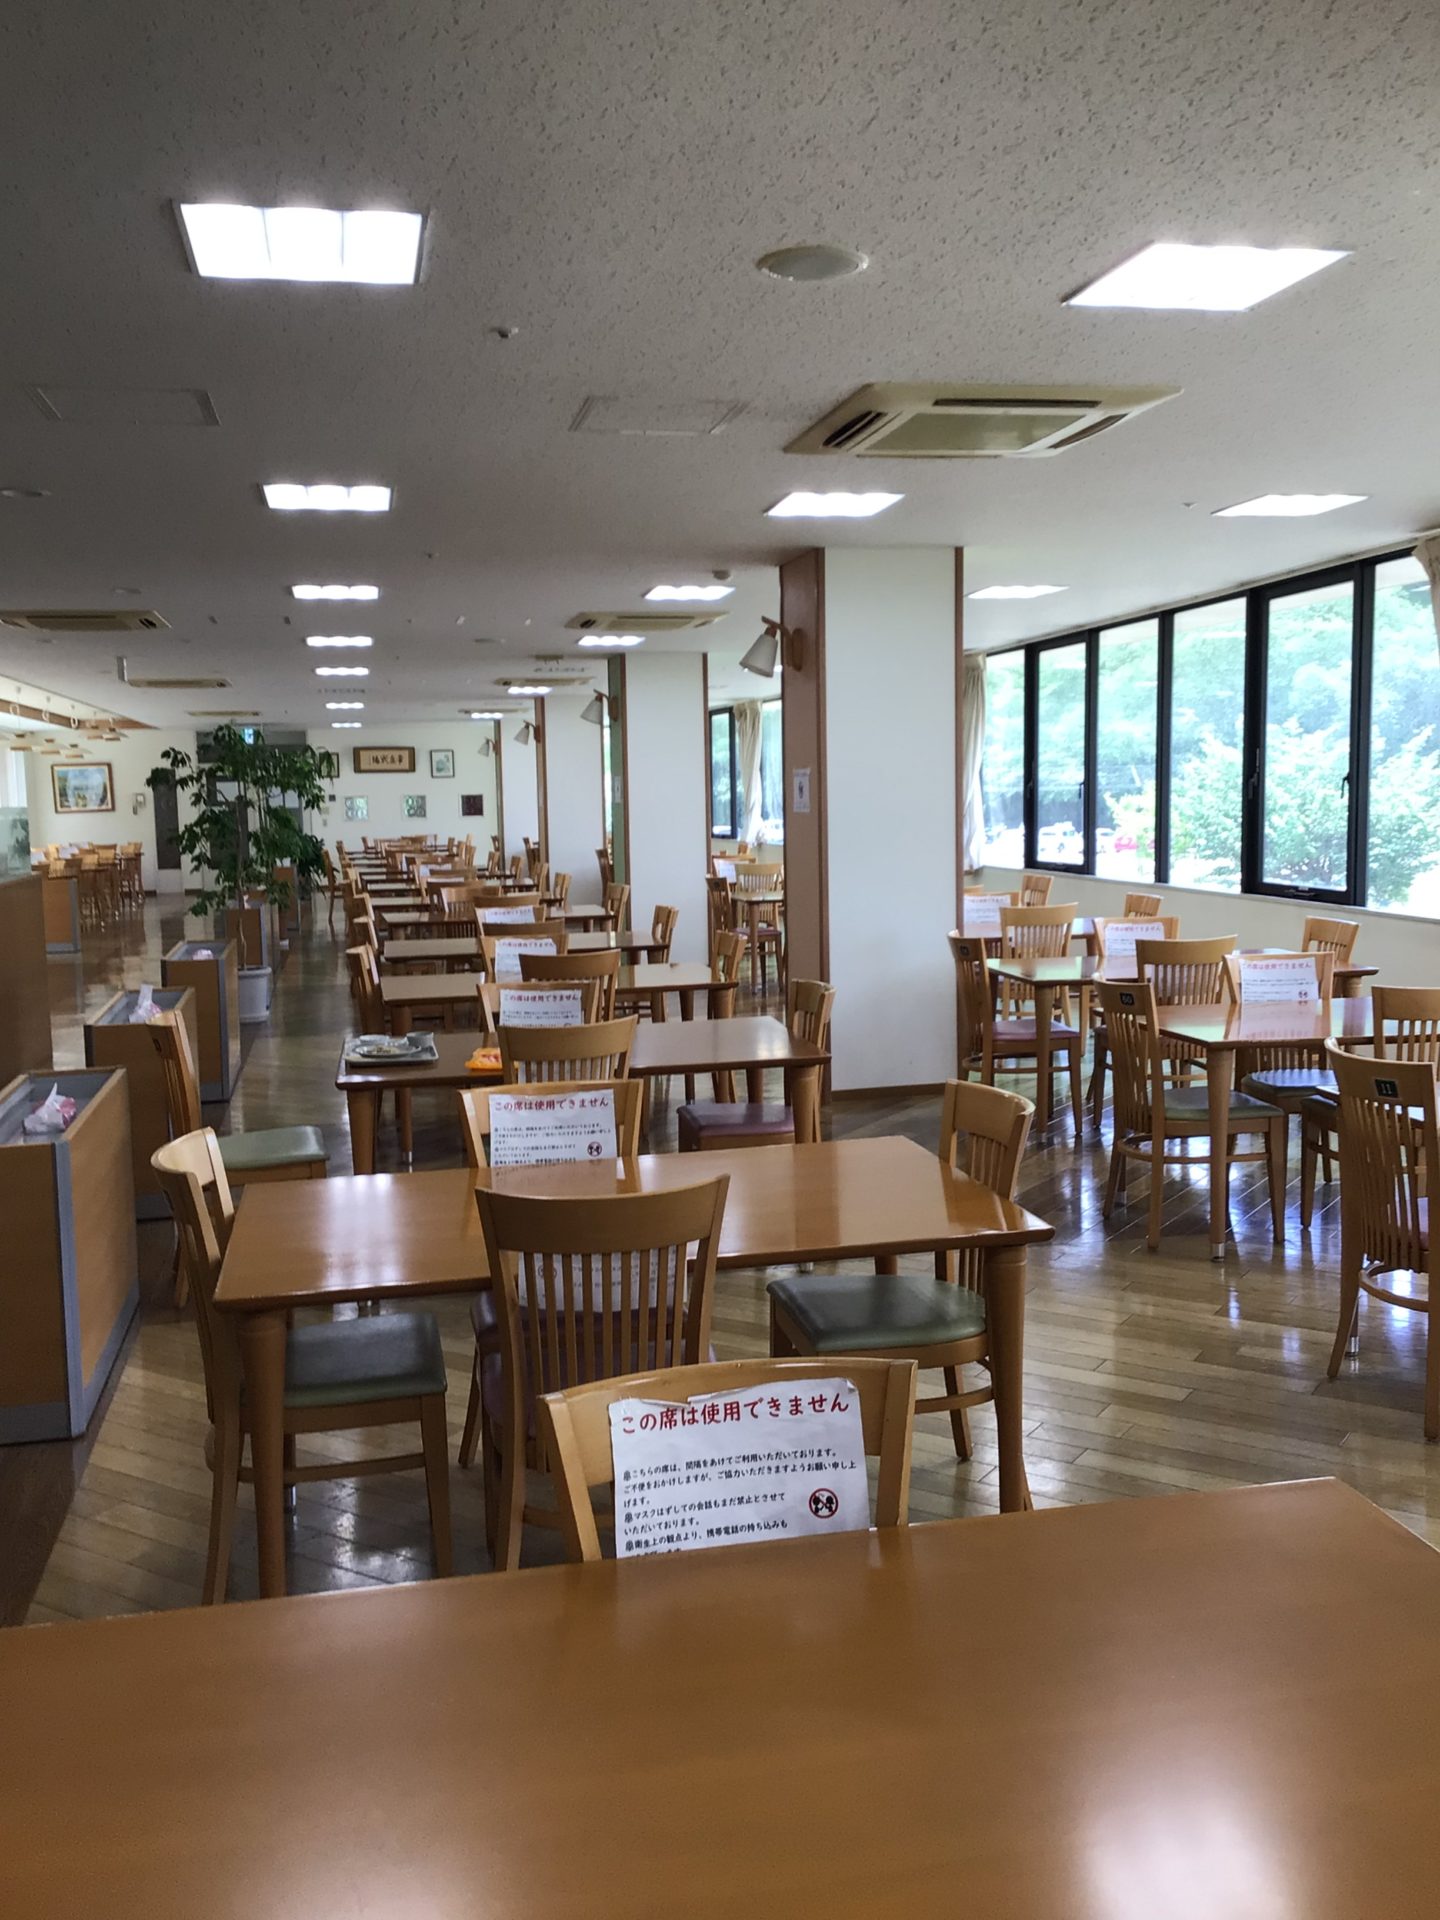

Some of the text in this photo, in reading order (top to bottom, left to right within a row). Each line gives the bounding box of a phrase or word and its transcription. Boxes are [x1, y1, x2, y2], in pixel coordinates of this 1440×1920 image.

[495, 1096, 609, 1112] この席は使用できません
[622, 1393, 850, 1435] この席は使用できません
